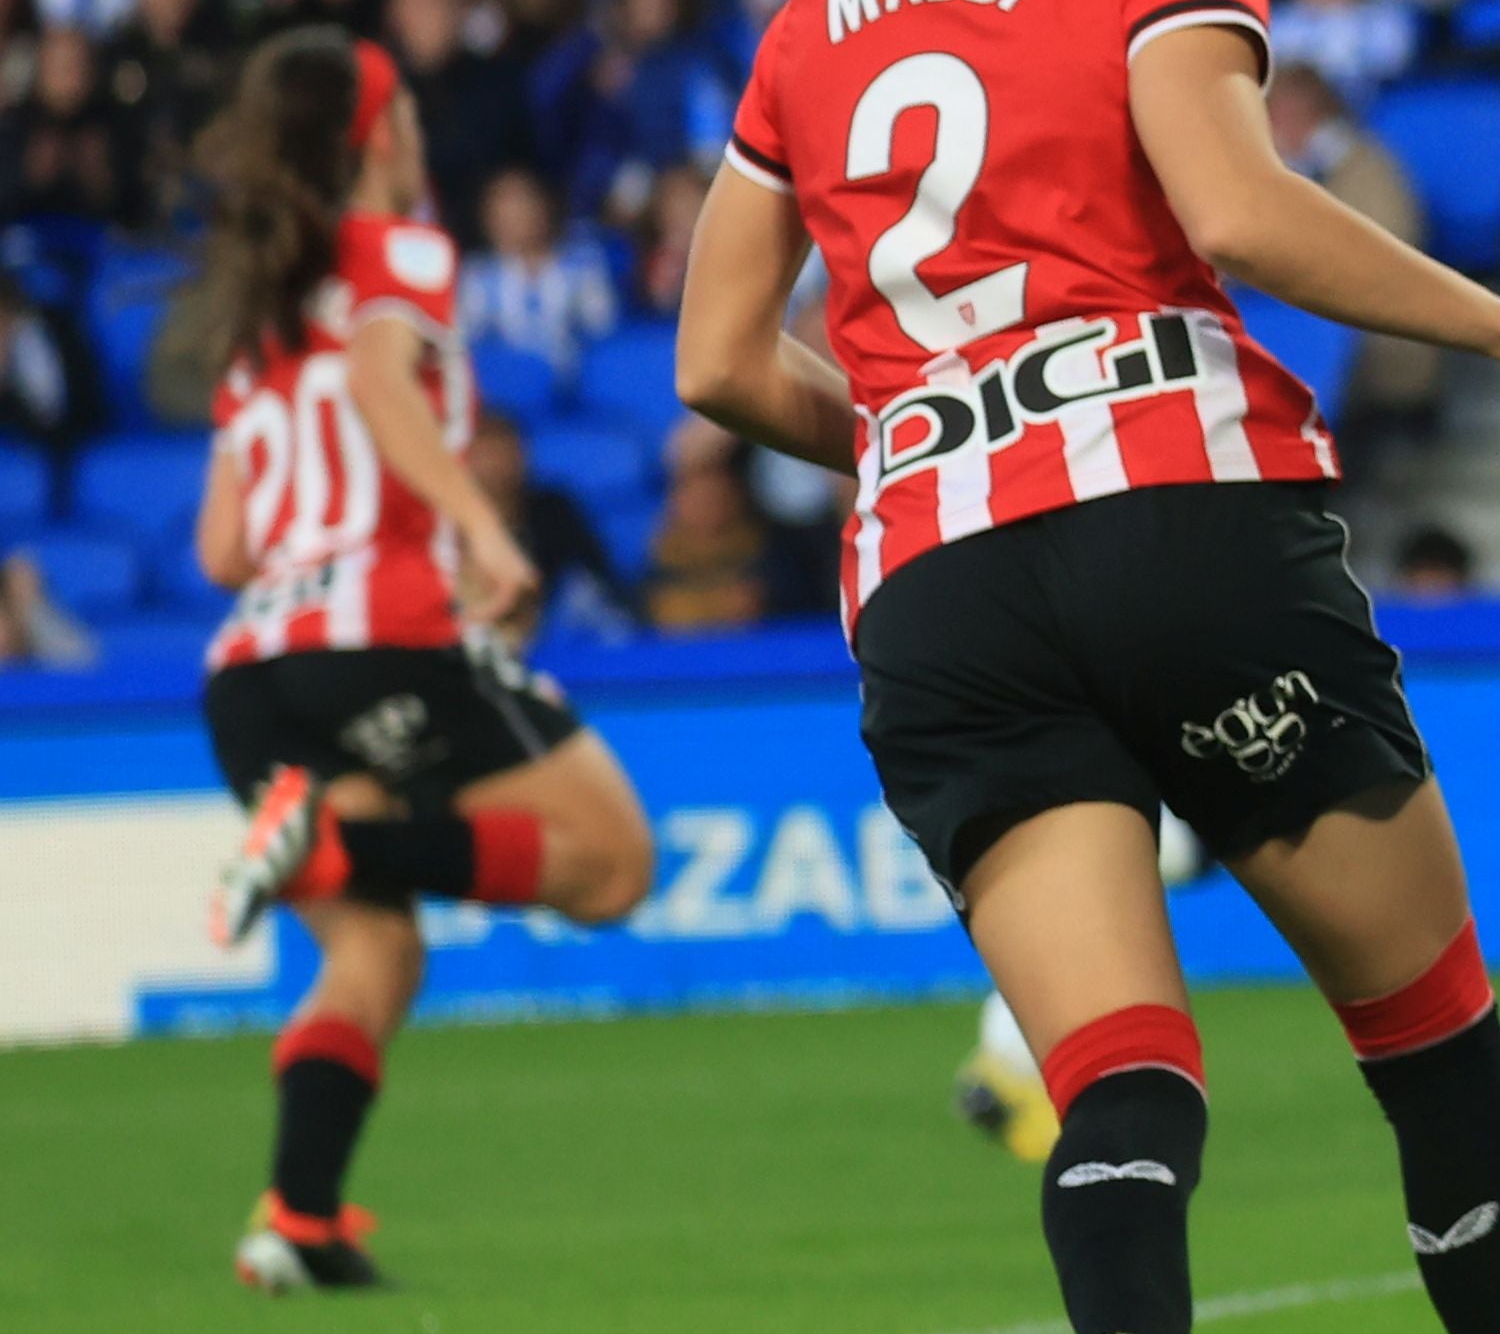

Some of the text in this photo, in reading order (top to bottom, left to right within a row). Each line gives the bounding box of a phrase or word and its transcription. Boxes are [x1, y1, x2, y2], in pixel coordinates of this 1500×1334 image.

[845, 51, 1029, 352] 2
[228, 352, 381, 555] 20
[876, 312, 1201, 483] DIGI
